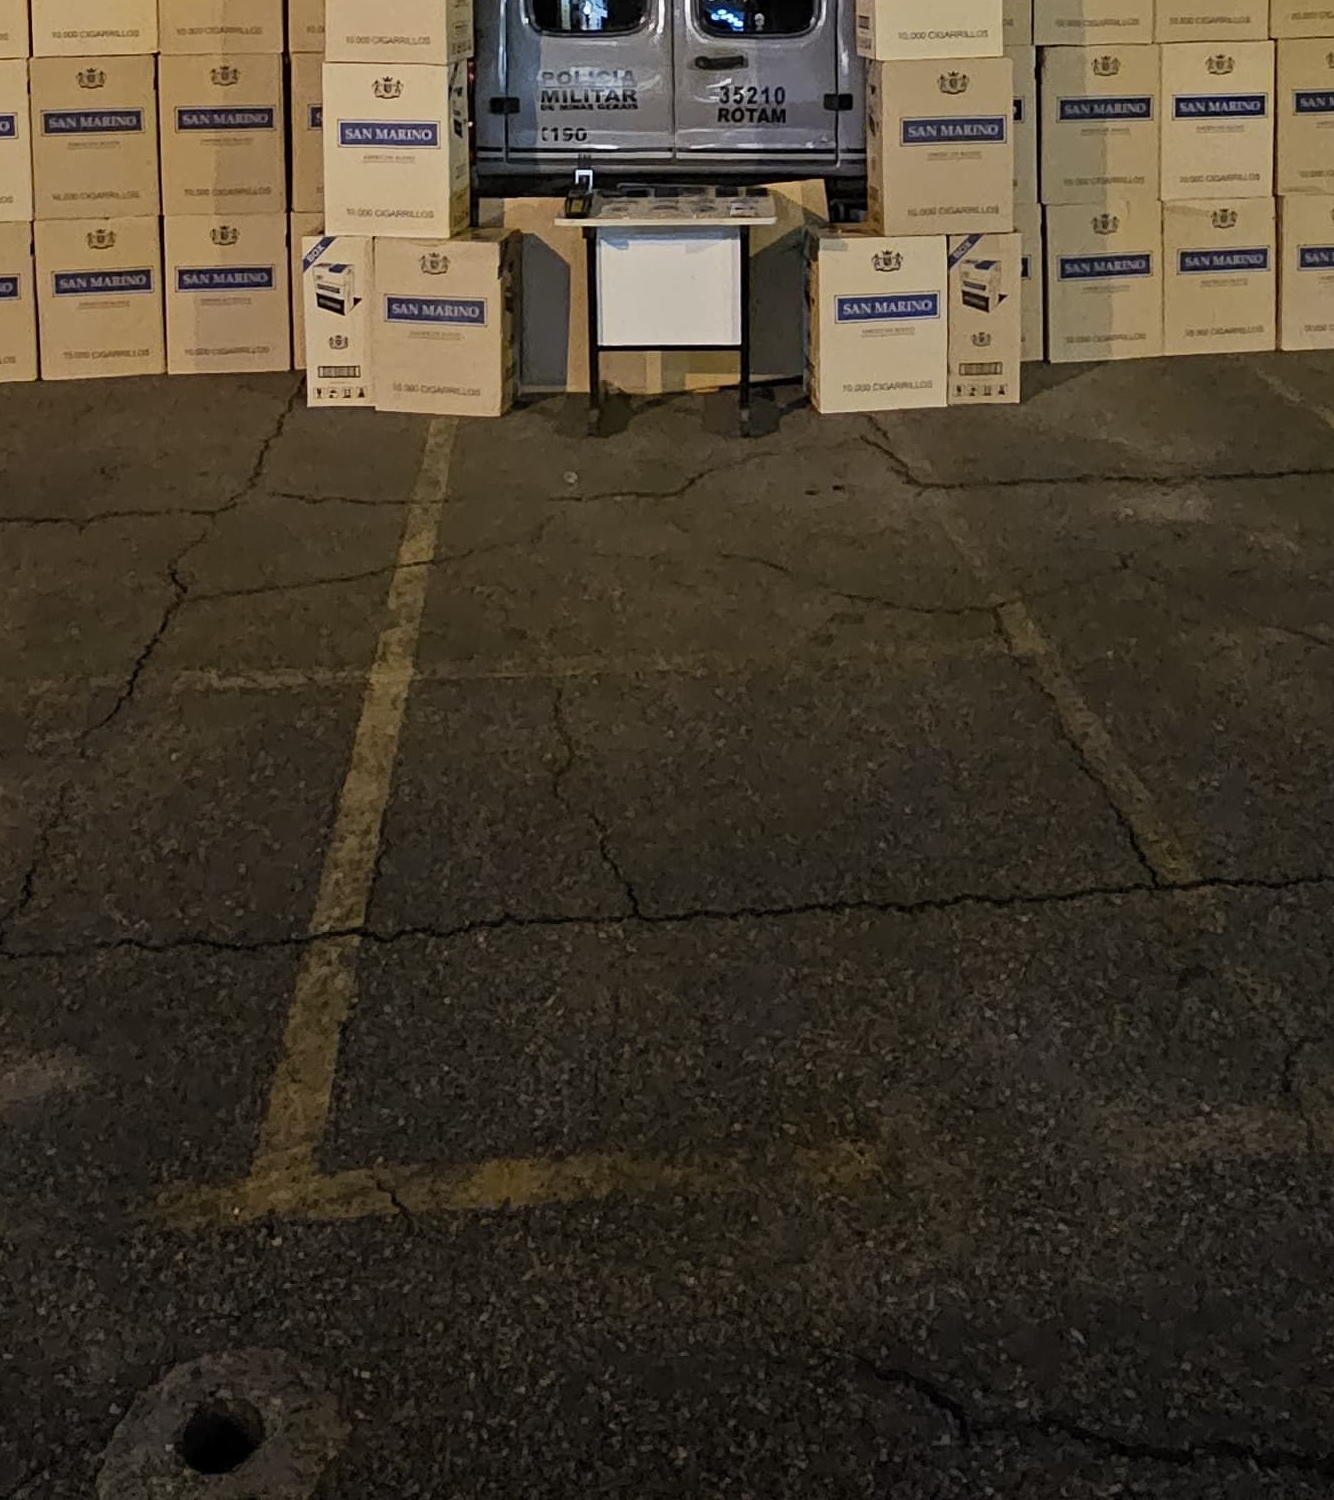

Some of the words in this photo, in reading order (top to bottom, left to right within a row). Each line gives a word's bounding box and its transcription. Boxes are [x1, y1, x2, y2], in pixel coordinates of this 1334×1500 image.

[540, 89, 638, 103] MILITAR
[719, 86, 786, 105] 35210
[1179, 101, 1205, 114] SAN
[1209, 100, 1260, 113] MARINO
[49, 116, 76, 128] SAN
[81, 114, 136, 128] MARINO
[717, 107, 787, 124] ROTAM
[346, 128, 373, 140] SAN
[377, 128, 431, 140] MARINO
[908, 125, 937, 138] SAN
[941, 124, 998, 137] MARINO
[59, 276, 87, 288] SAN
[91, 275, 146, 288] MARINO
[392, 303, 419, 316] SAN
[424, 303, 479, 317] MARINO
[843, 302, 871, 315] SAN
[875, 300, 932, 314] MARINO
